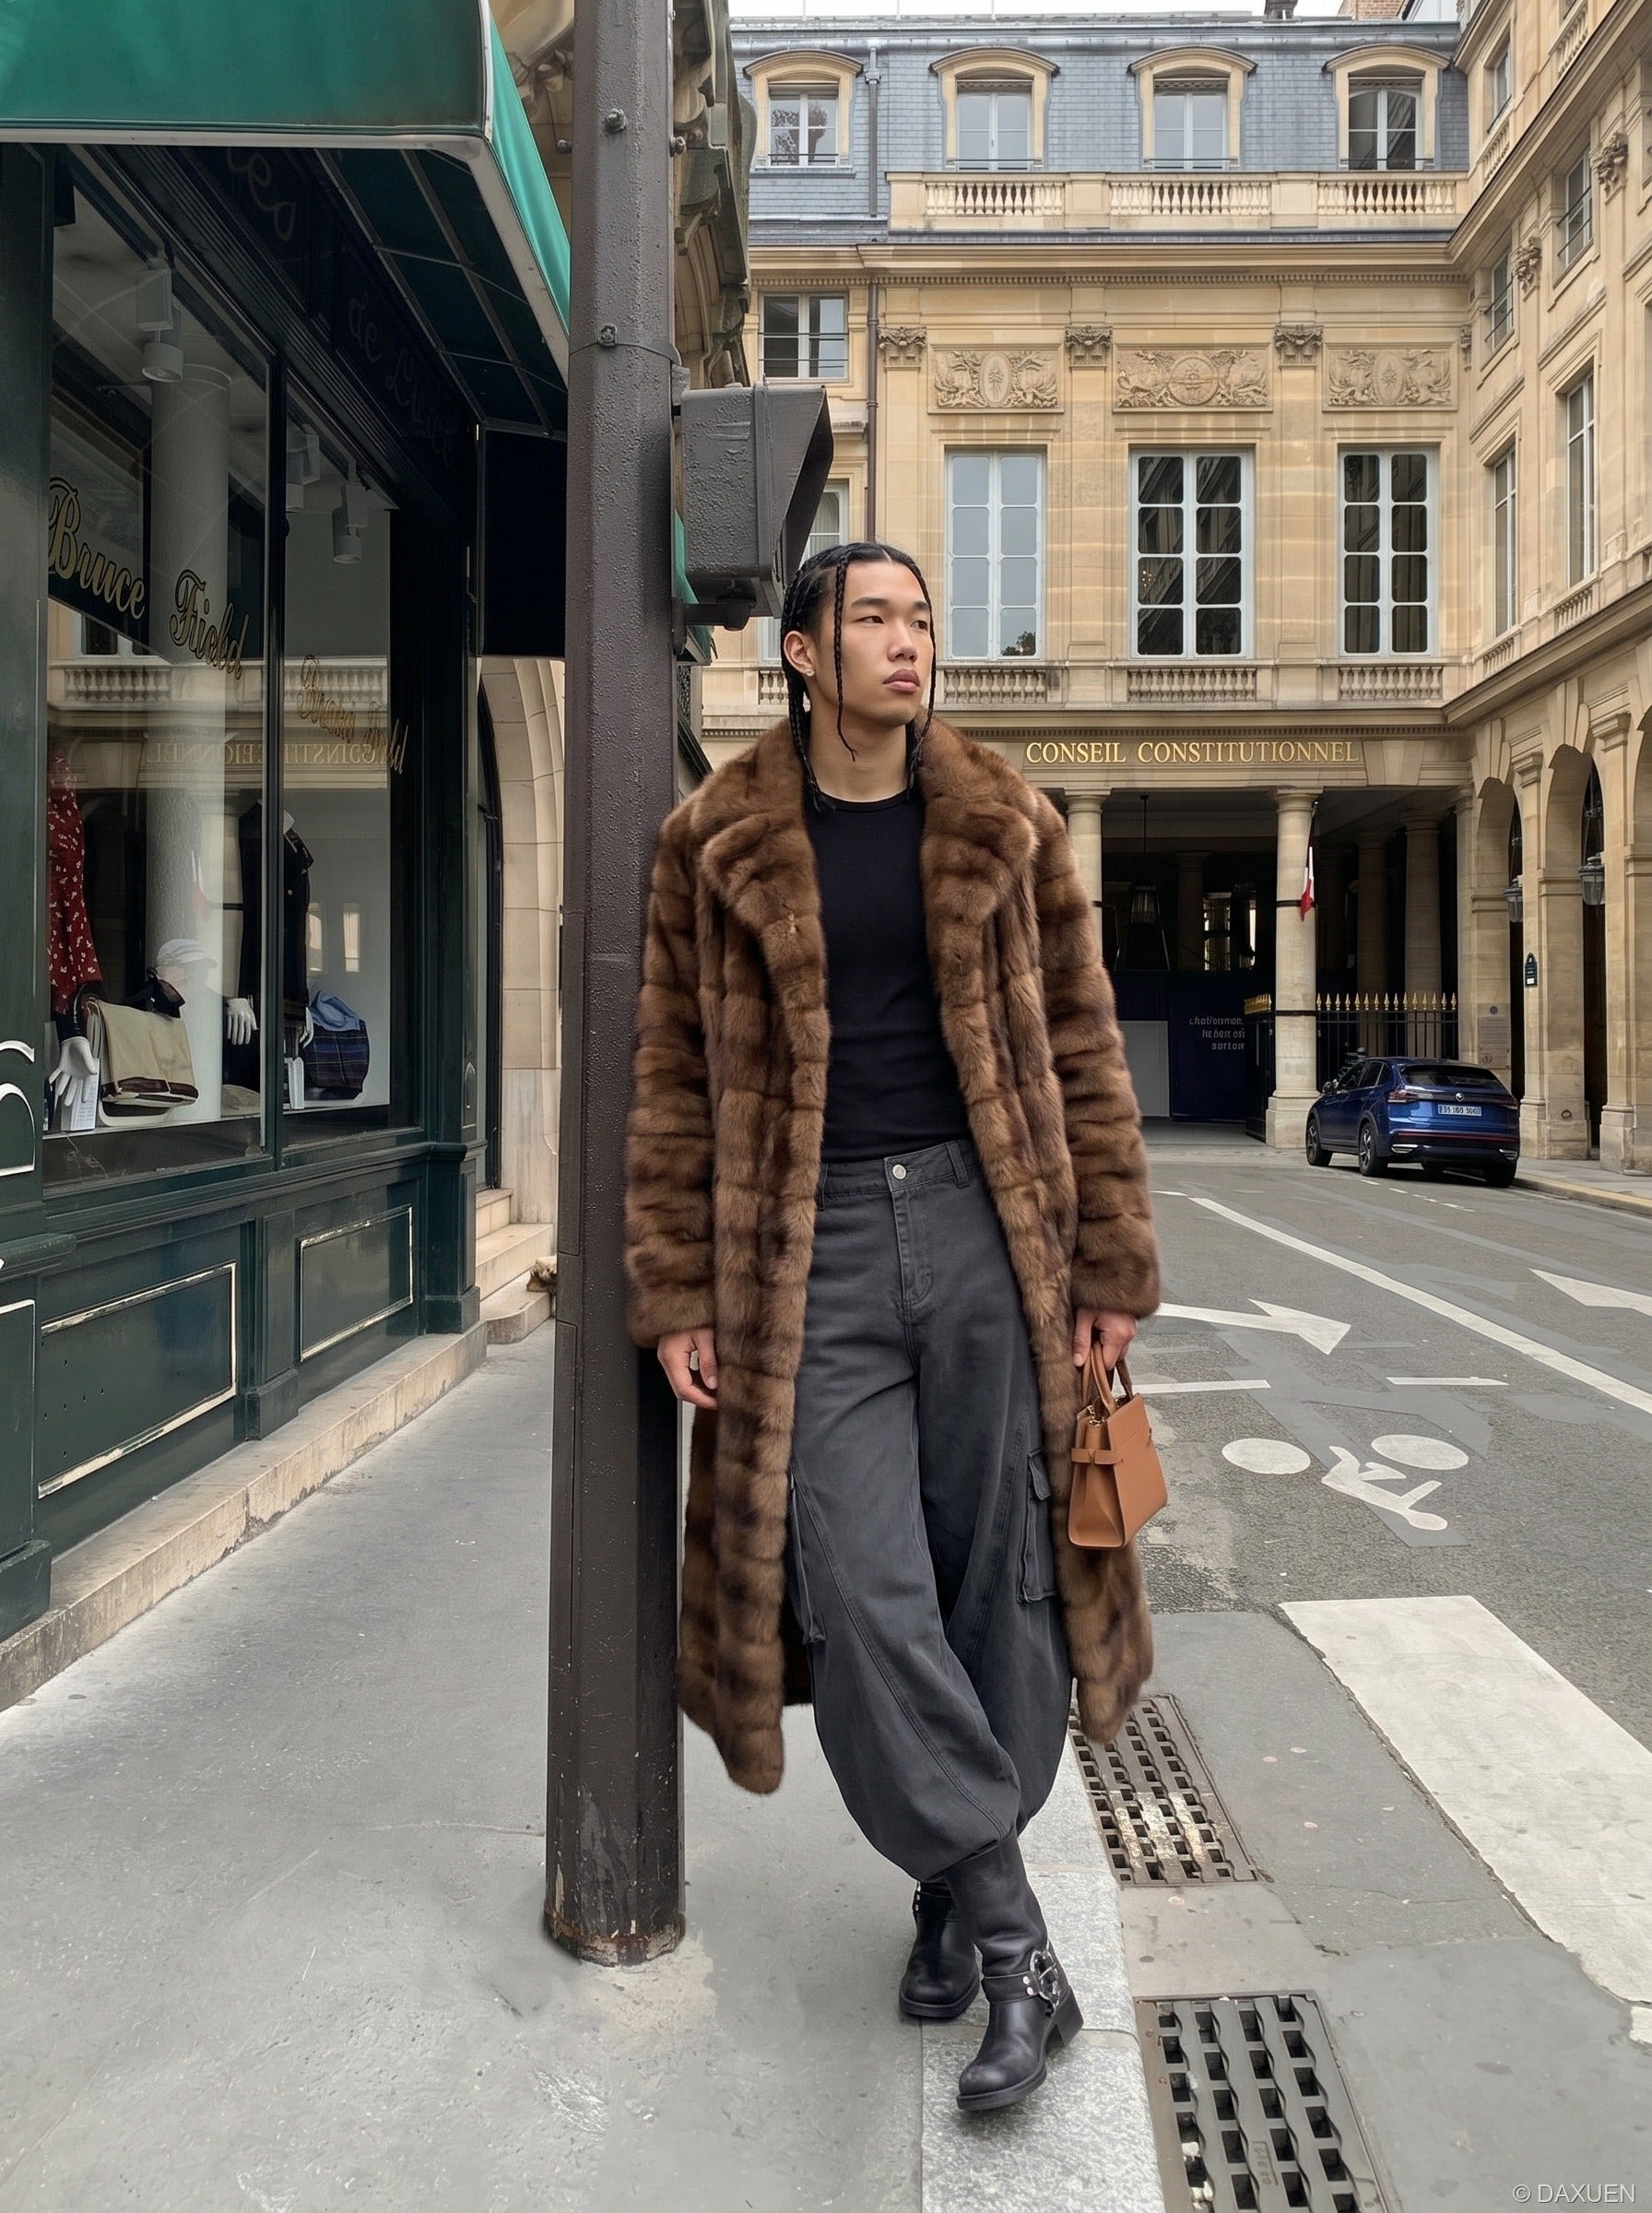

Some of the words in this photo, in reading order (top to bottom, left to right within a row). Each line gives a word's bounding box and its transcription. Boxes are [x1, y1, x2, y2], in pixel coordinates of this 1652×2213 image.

[49, 476, 145, 620] Bruce
[170, 568, 250, 680] Field
[1025, 741, 1127, 763] CONSEIL
[1137, 740, 1360, 763] CONSTITUTIONNEL
